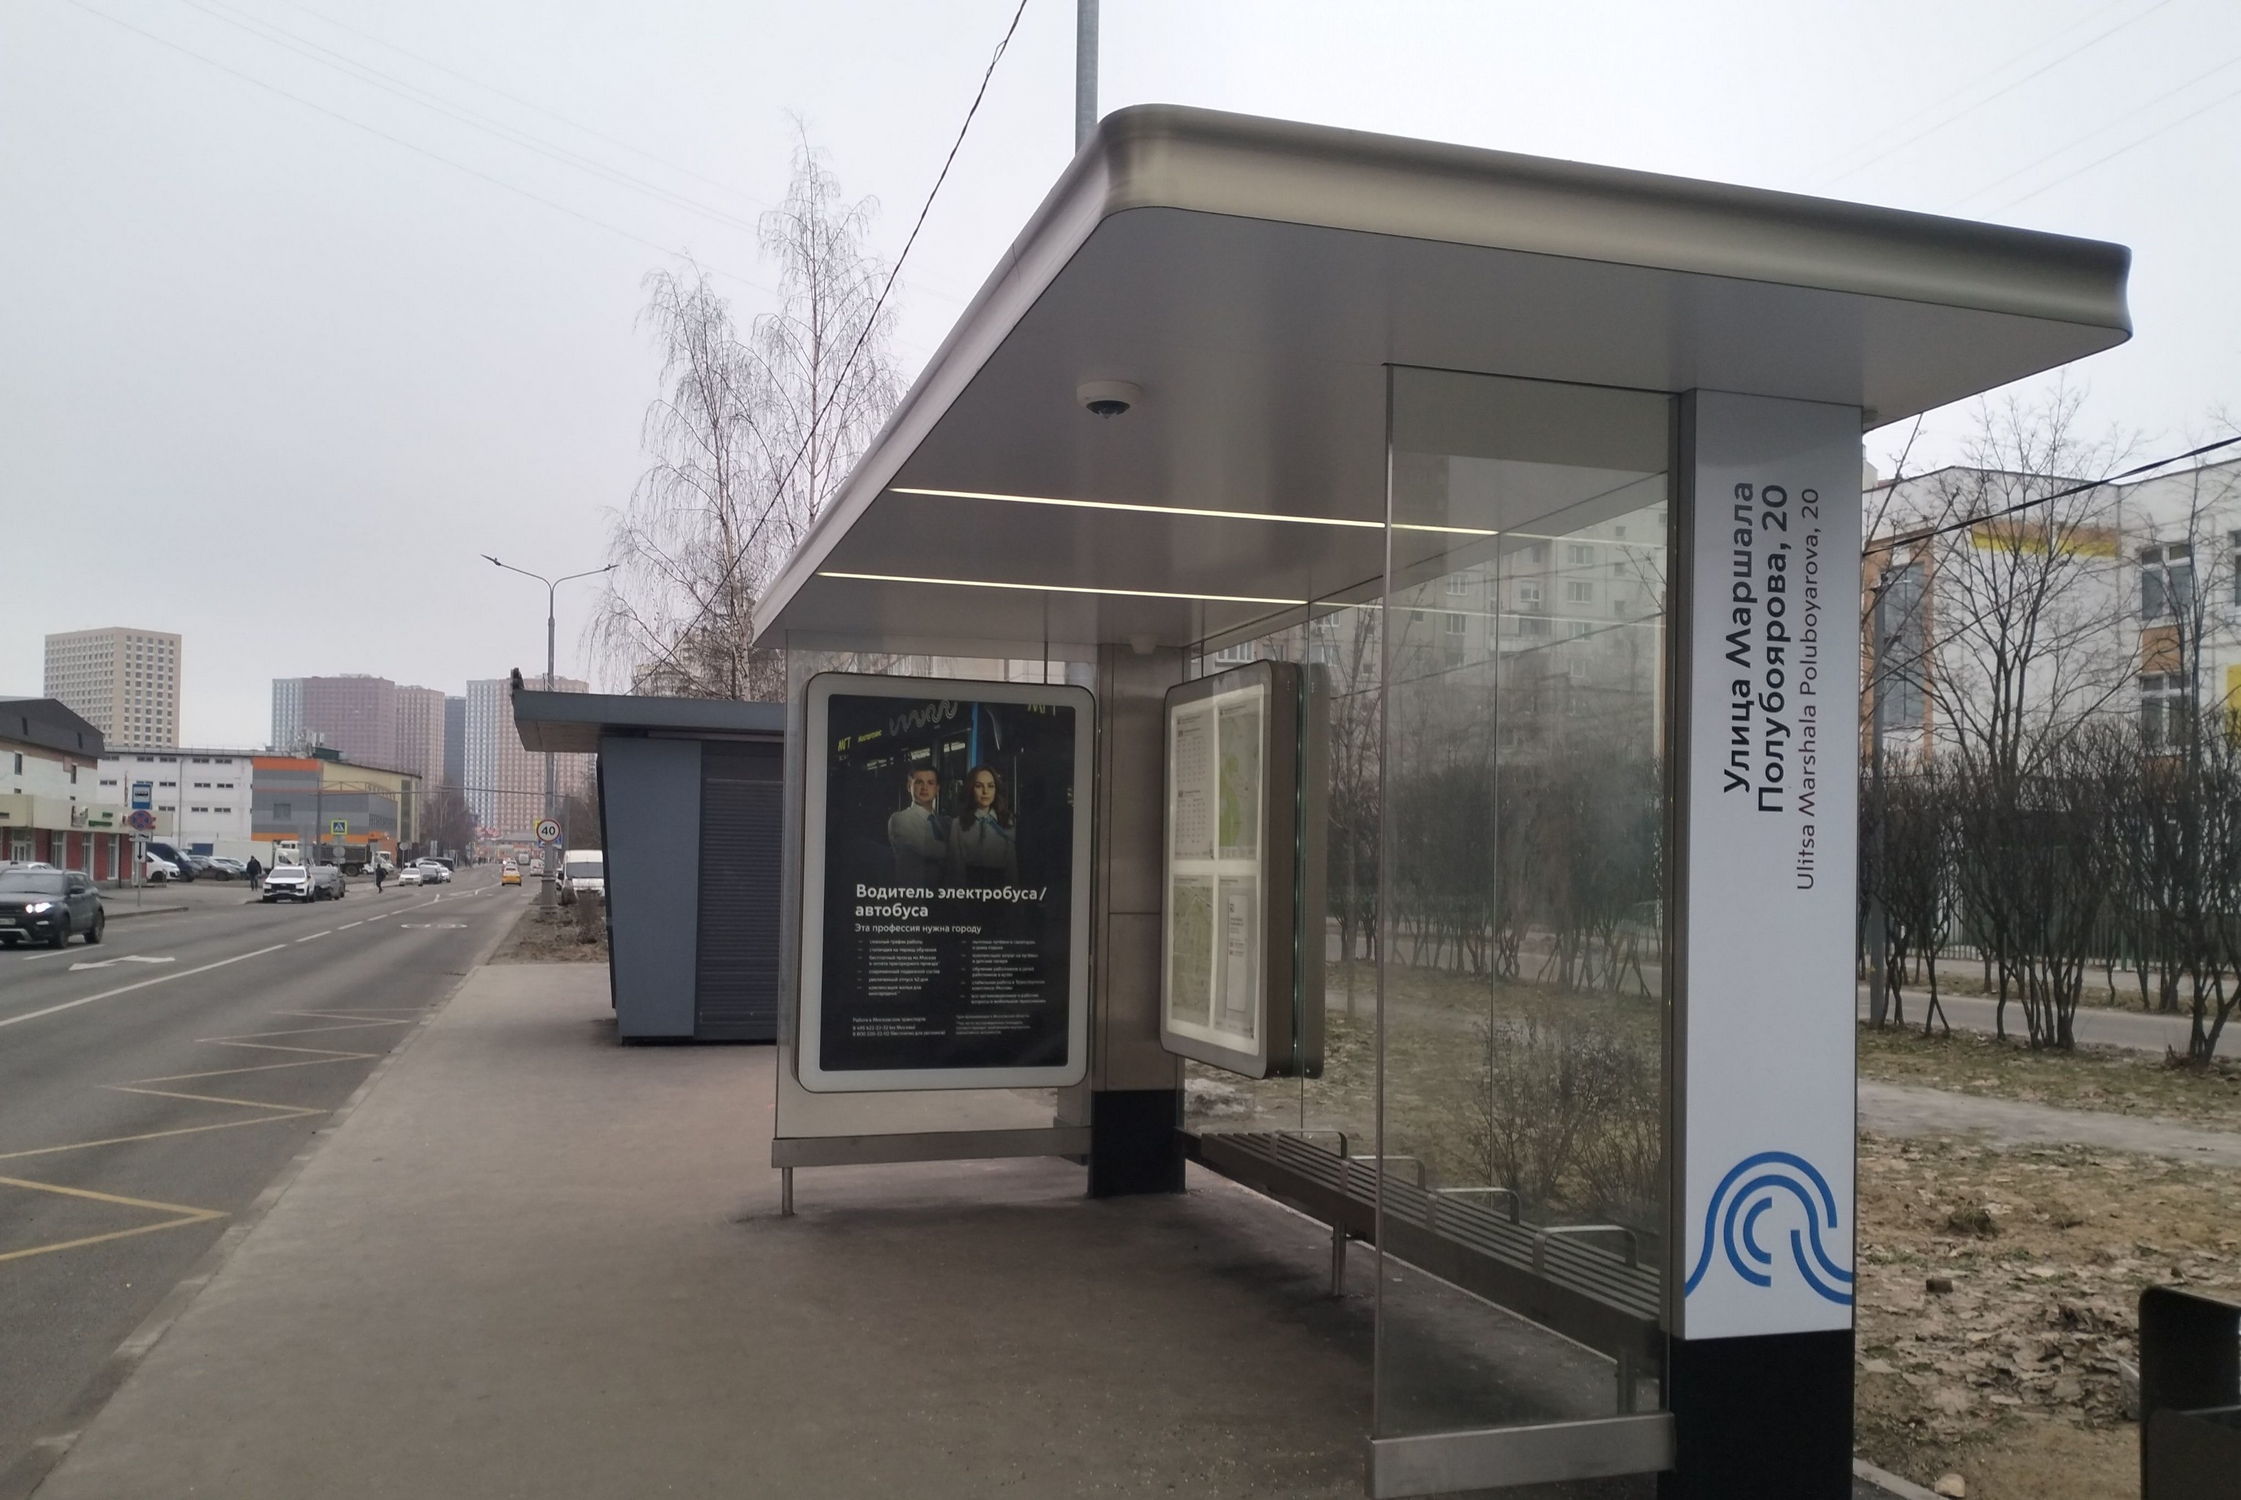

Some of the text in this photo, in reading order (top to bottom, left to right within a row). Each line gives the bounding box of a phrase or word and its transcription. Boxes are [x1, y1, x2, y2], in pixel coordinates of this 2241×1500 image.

[1723, 482, 1758, 794] Улица Маршала
[1757, 484, 1792, 813] Полубоярова, 20
[1795, 488, 1822, 890] Ulitsa Marshala Poluboyarova, 20
[541, 826, 555, 835] 40
[856, 884, 934, 900] Водитель
[855, 903, 929, 920] автобуса
[855, 923, 981, 935] Эта профессия нужна городу
